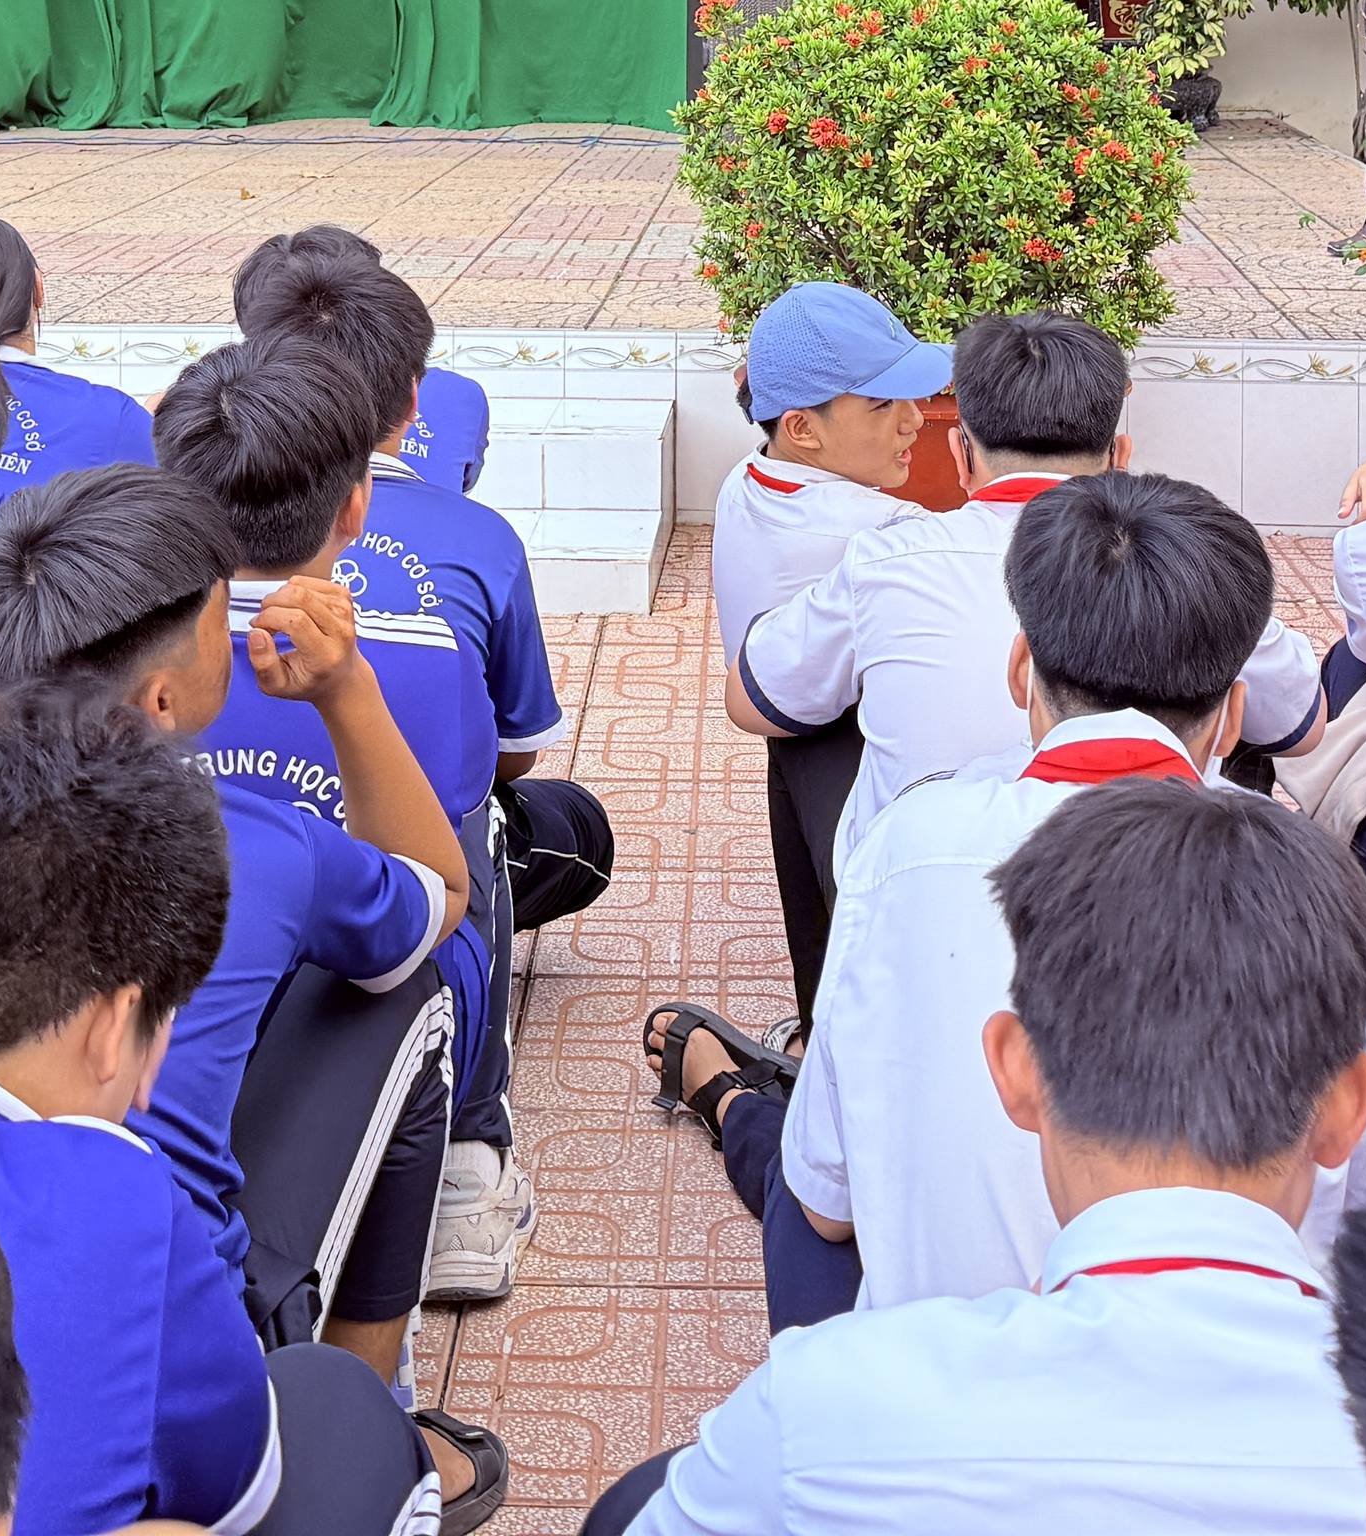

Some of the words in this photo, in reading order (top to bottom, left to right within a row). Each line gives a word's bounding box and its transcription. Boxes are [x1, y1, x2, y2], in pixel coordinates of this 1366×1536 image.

[16, 409, 40, 430] CƠ
[24, 431, 47, 453] SỞ
[400, 437, 429, 459] IÊN
[361, 531, 404, 559] HỌC
[401, 553, 430, 579] CƠ
[416, 579, 444, 609] SỞ
[282, 755, 341, 801] HỌC
